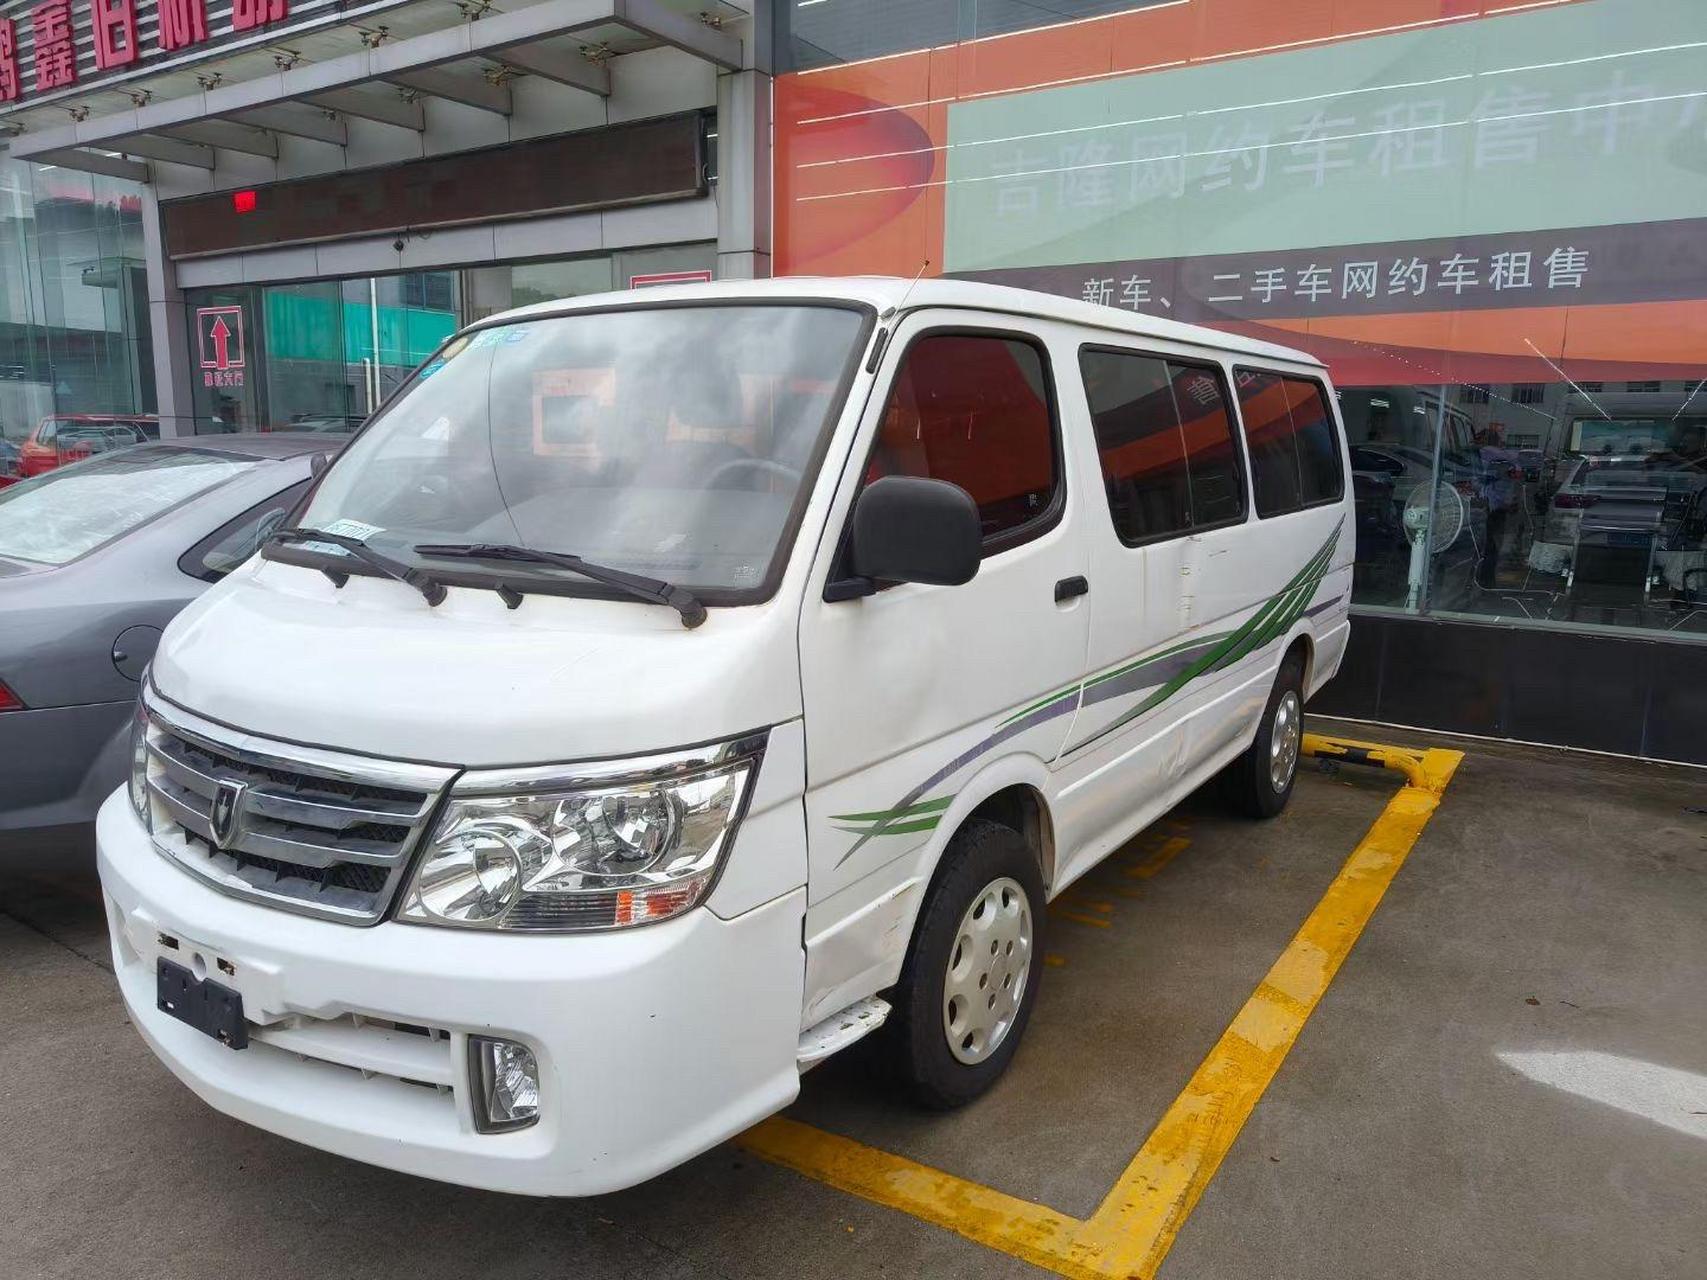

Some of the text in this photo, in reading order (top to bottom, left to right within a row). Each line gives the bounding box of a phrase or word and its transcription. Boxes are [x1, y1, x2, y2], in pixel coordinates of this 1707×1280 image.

[989, 68, 1707, 218] 吉隆网约车租售中
